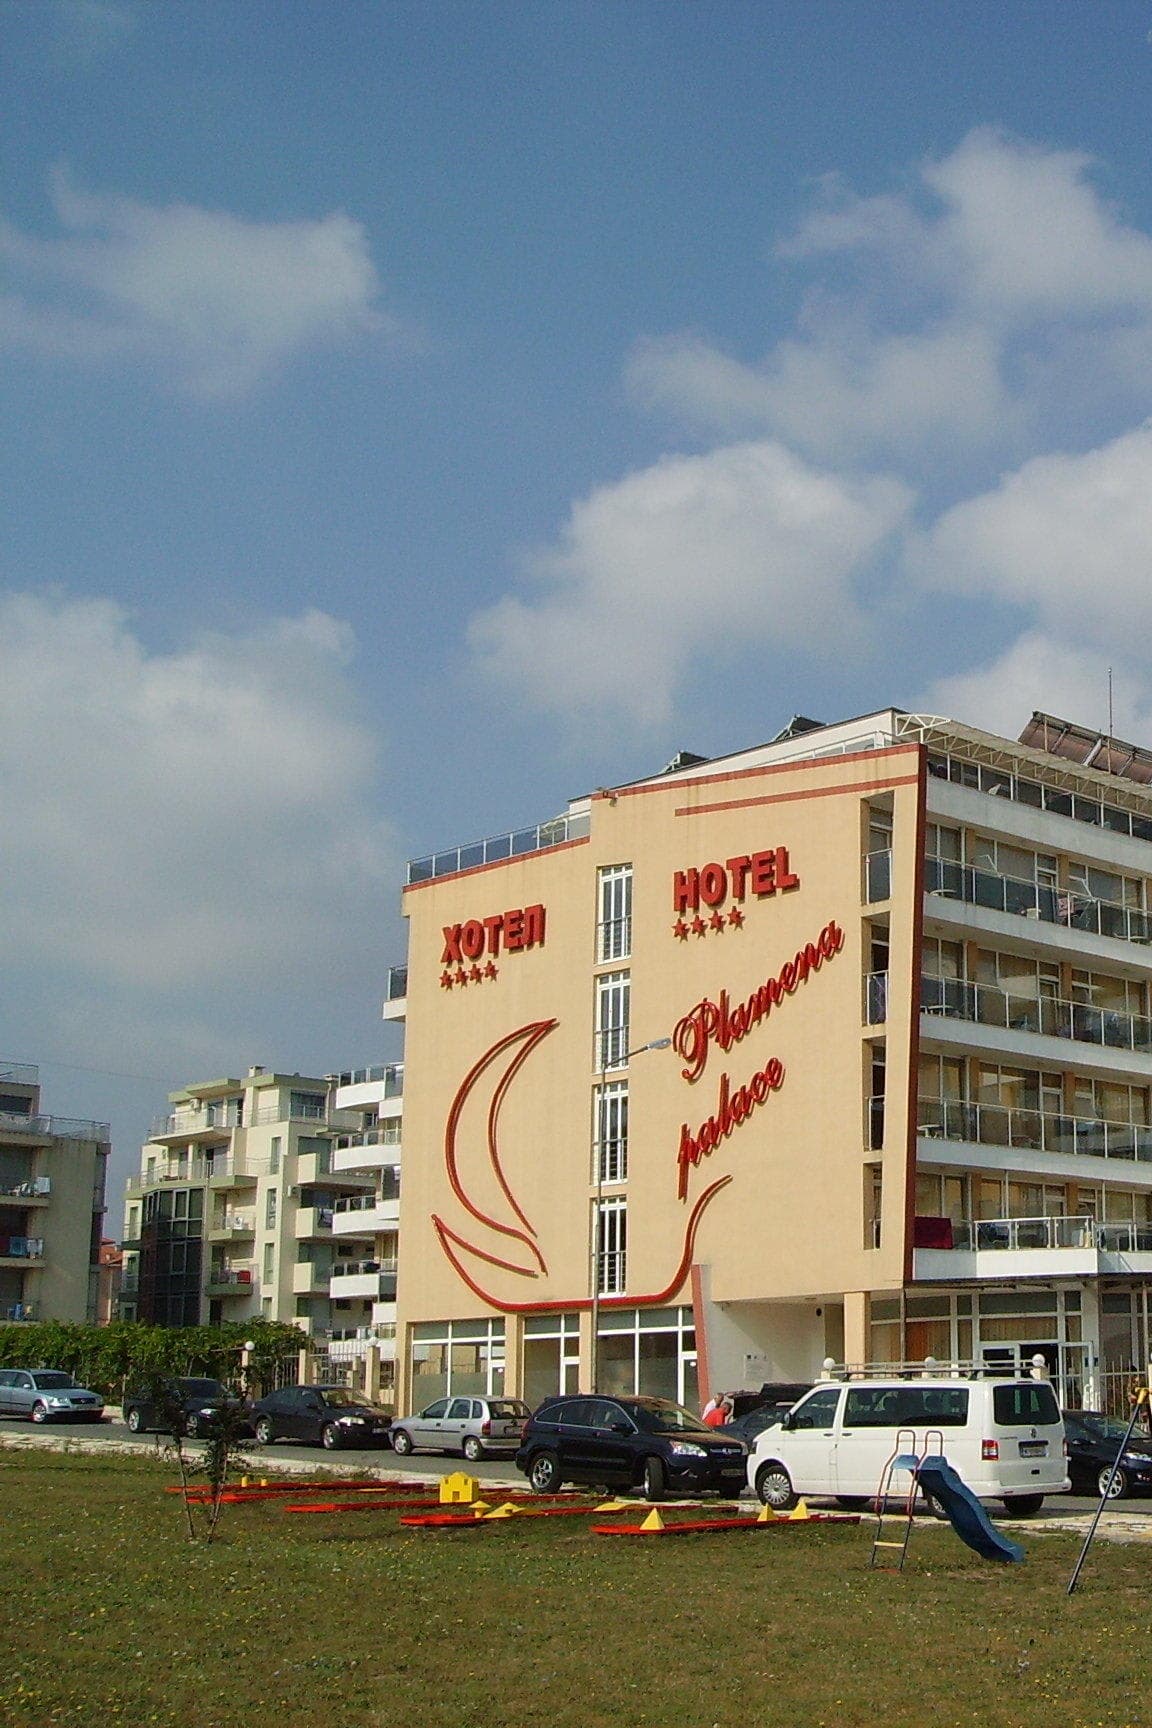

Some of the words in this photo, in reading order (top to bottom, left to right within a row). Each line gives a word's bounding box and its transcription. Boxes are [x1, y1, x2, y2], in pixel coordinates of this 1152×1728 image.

[673, 846, 799, 916] HOTEL
[440, 904, 546, 967] ХОТЕЛ
[673, 920, 844, 1082] Plamena
[677, 1057, 785, 1202] palace
